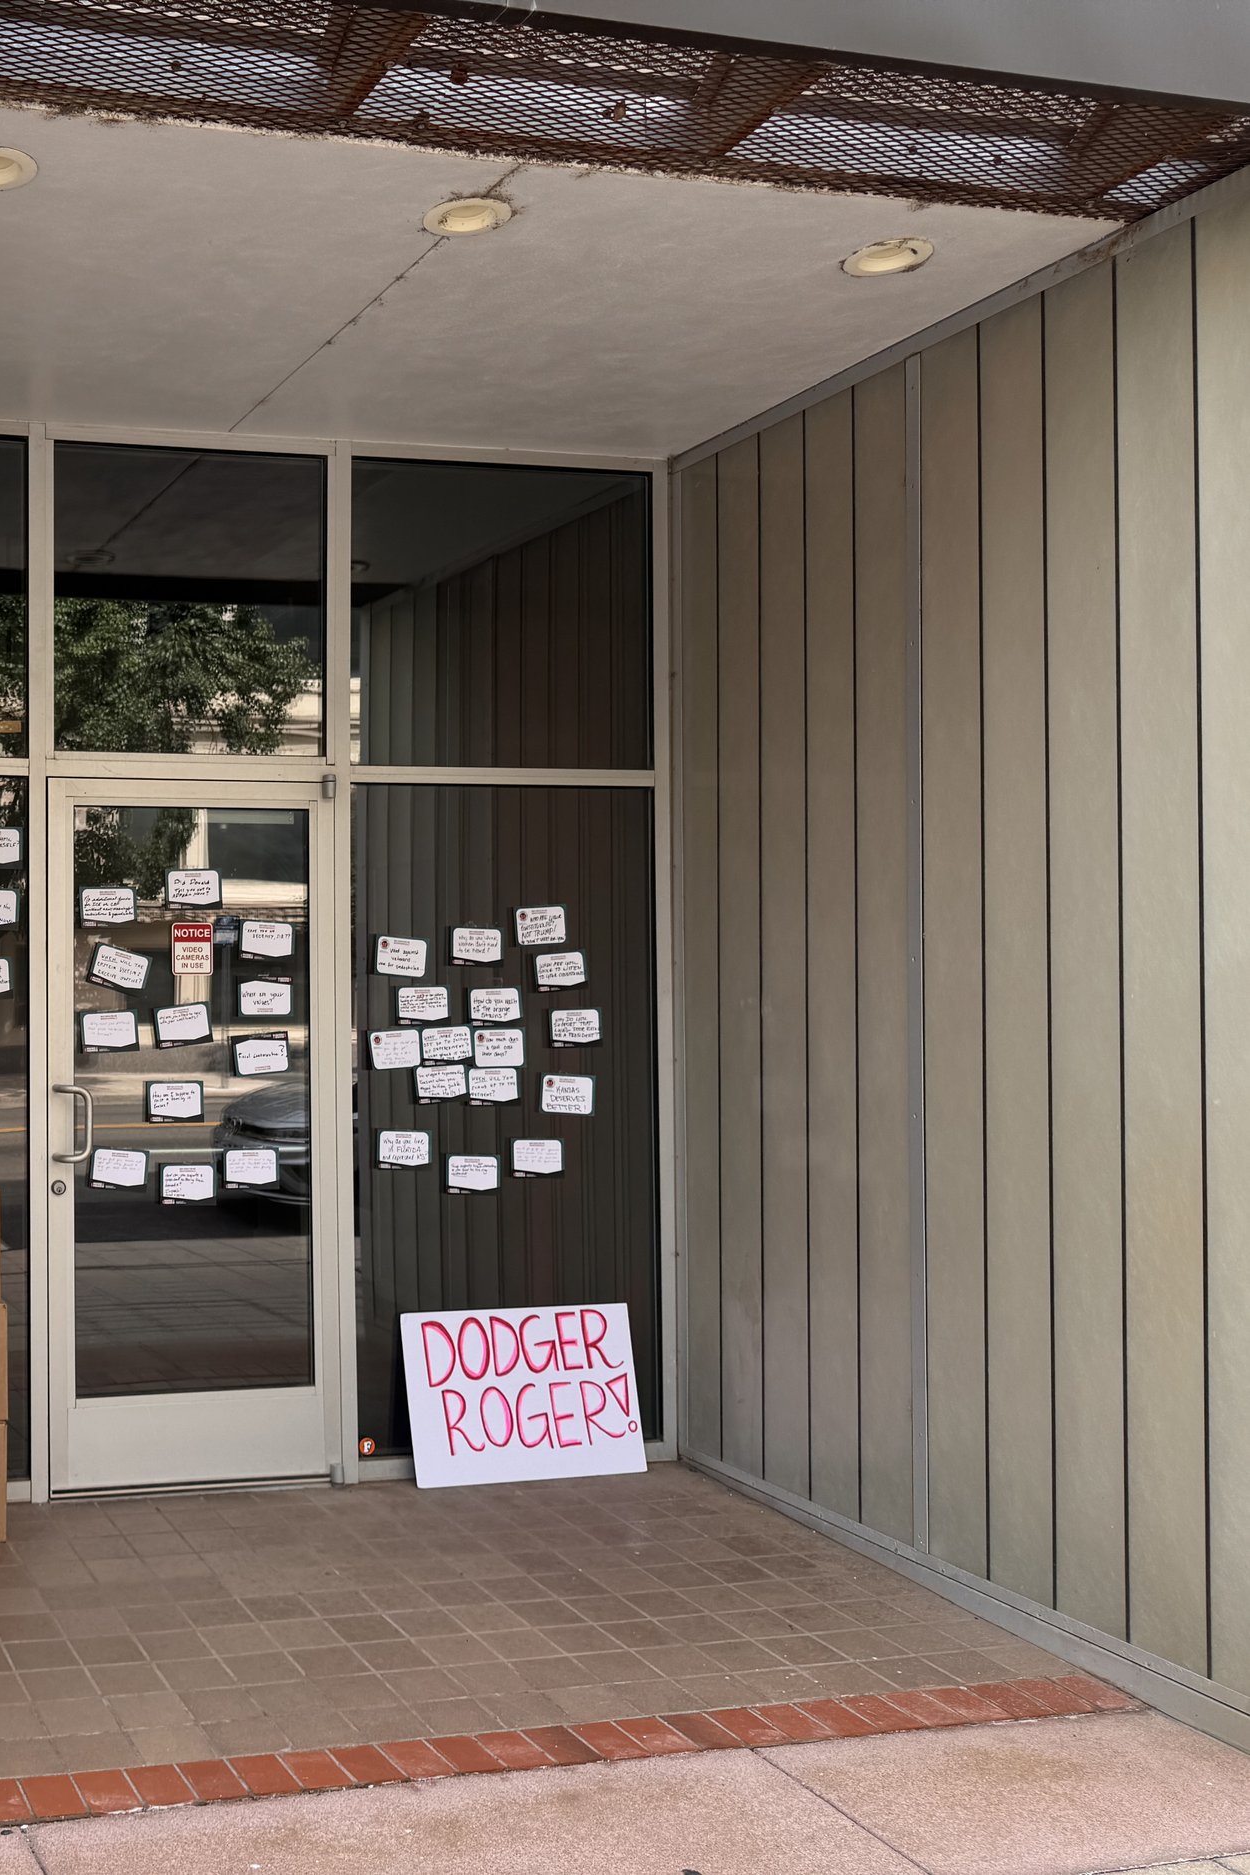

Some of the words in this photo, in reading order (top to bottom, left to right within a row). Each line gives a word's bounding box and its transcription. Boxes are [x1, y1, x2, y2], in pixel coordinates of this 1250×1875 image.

[174, 929, 210, 937] NOTICE
[546, 1103, 587, 1112] BETTER!
[421, 1309, 624, 1387] DODGER
[442, 1373, 638, 1456] ROGER!
